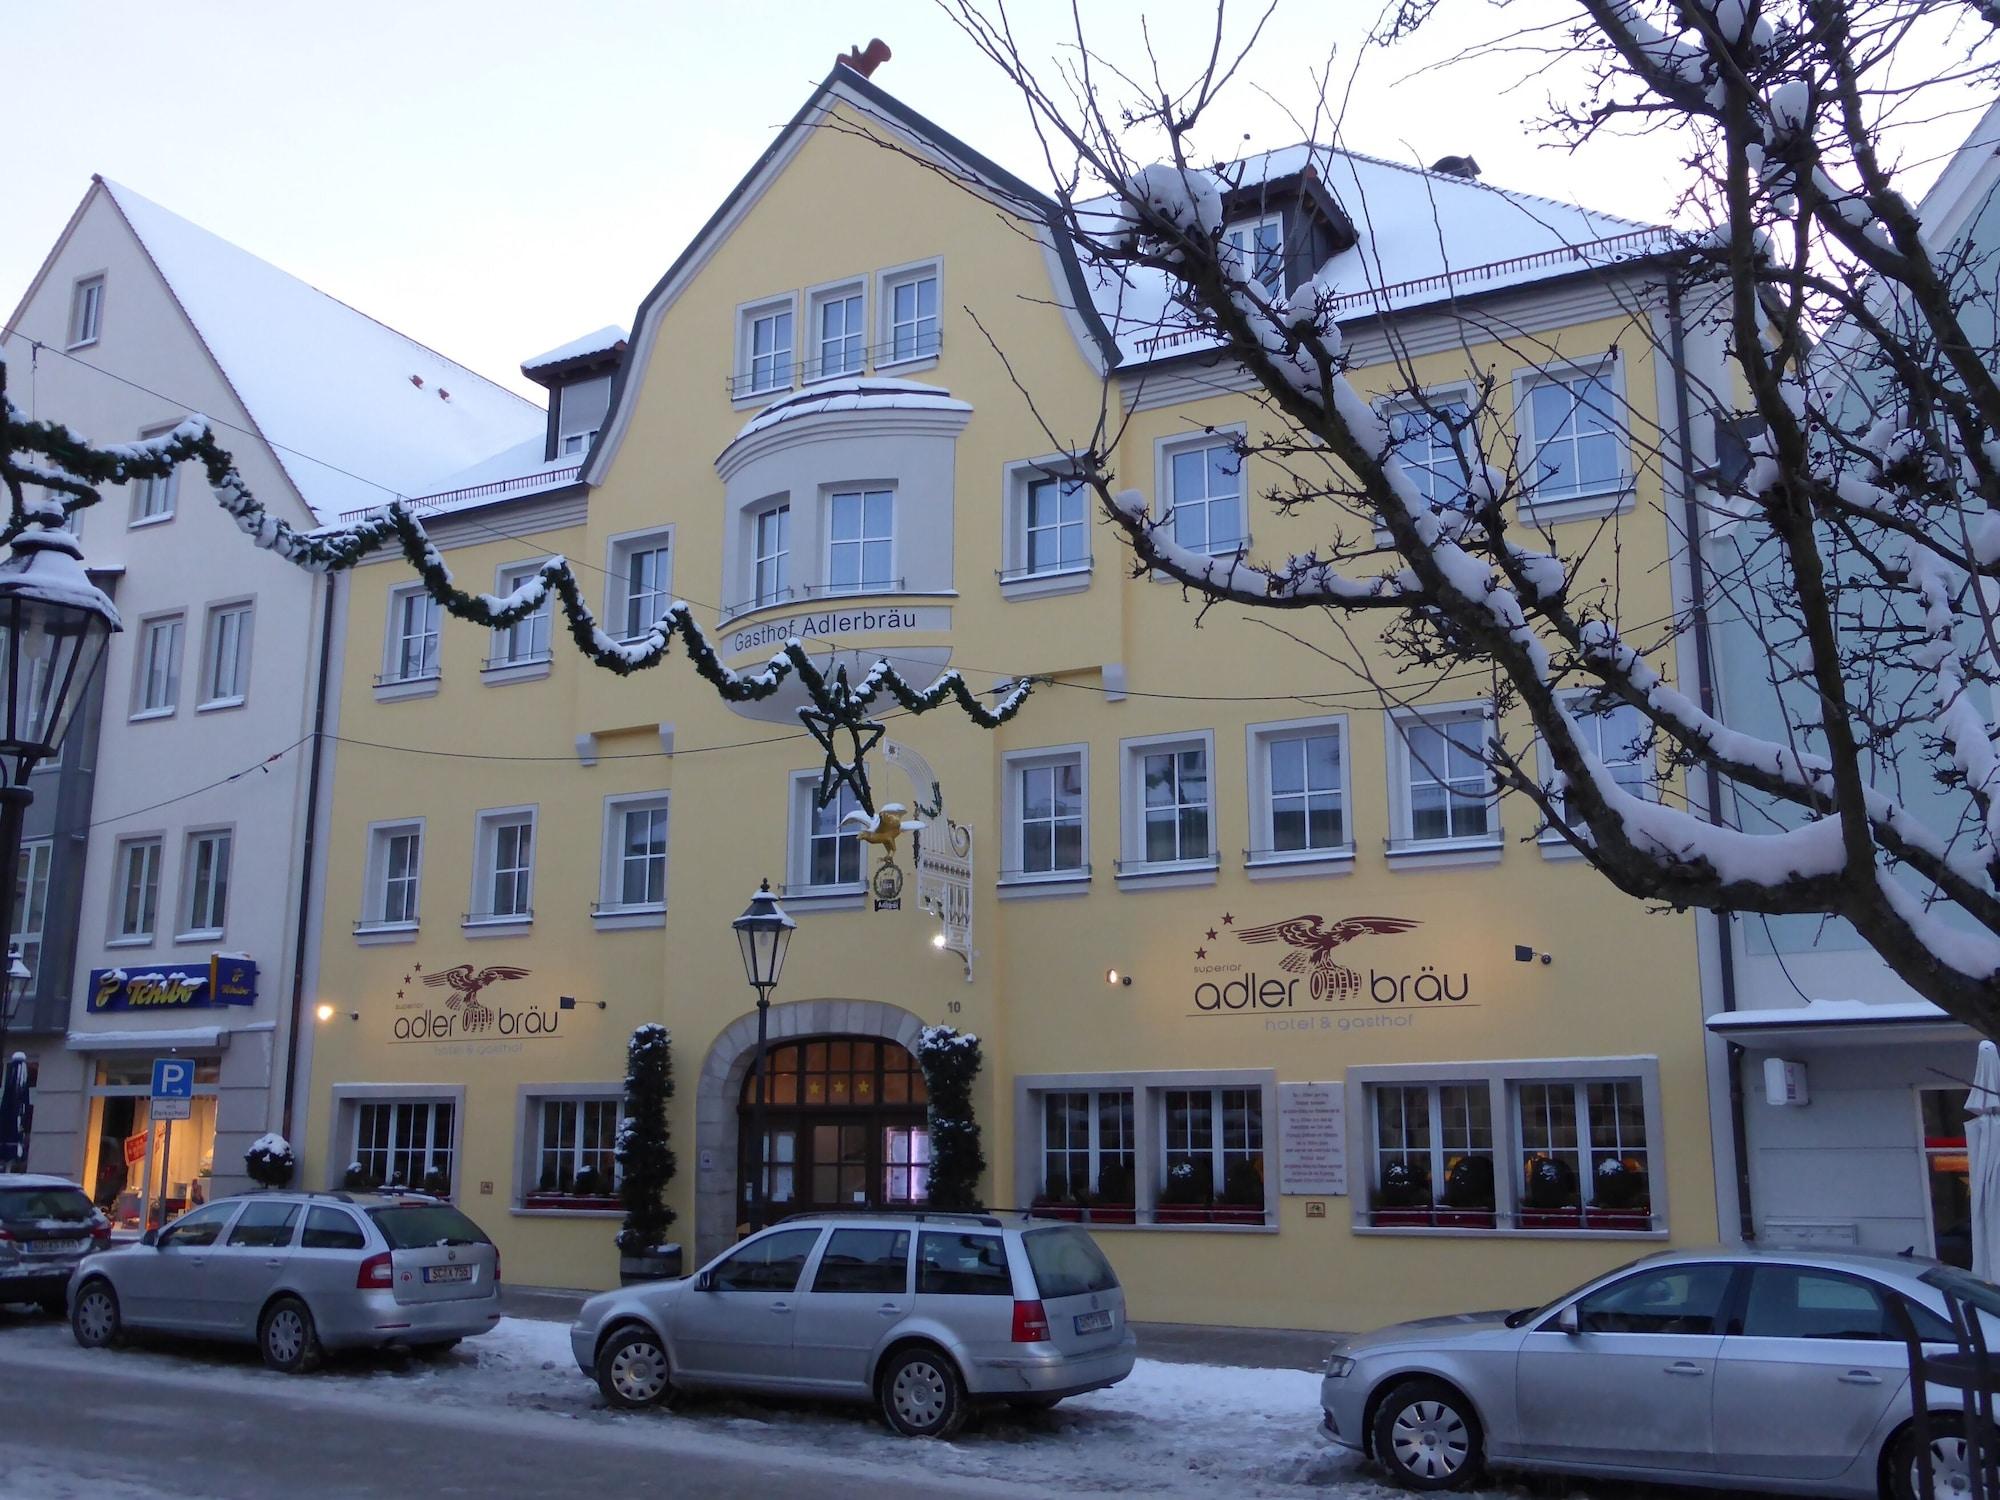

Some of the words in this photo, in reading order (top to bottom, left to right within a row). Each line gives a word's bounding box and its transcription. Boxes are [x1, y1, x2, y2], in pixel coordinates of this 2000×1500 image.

[735, 619, 796, 652] Gasthof
[802, 609, 916, 637] Adlerbräu
[1193, 963, 1242, 974] superior
[1194, 972, 1300, 1011] adler
[1370, 965, 1468, 1004] bräu
[393, 1008, 457, 1040] adler
[498, 1004, 558, 1036] bräu
[947, 1001, 961, 1014] 10
[1264, 1016, 1315, 1033] hotel
[1337, 1013, 1414, 1031] gasthof
[161, 1064, 184, 1093] P
